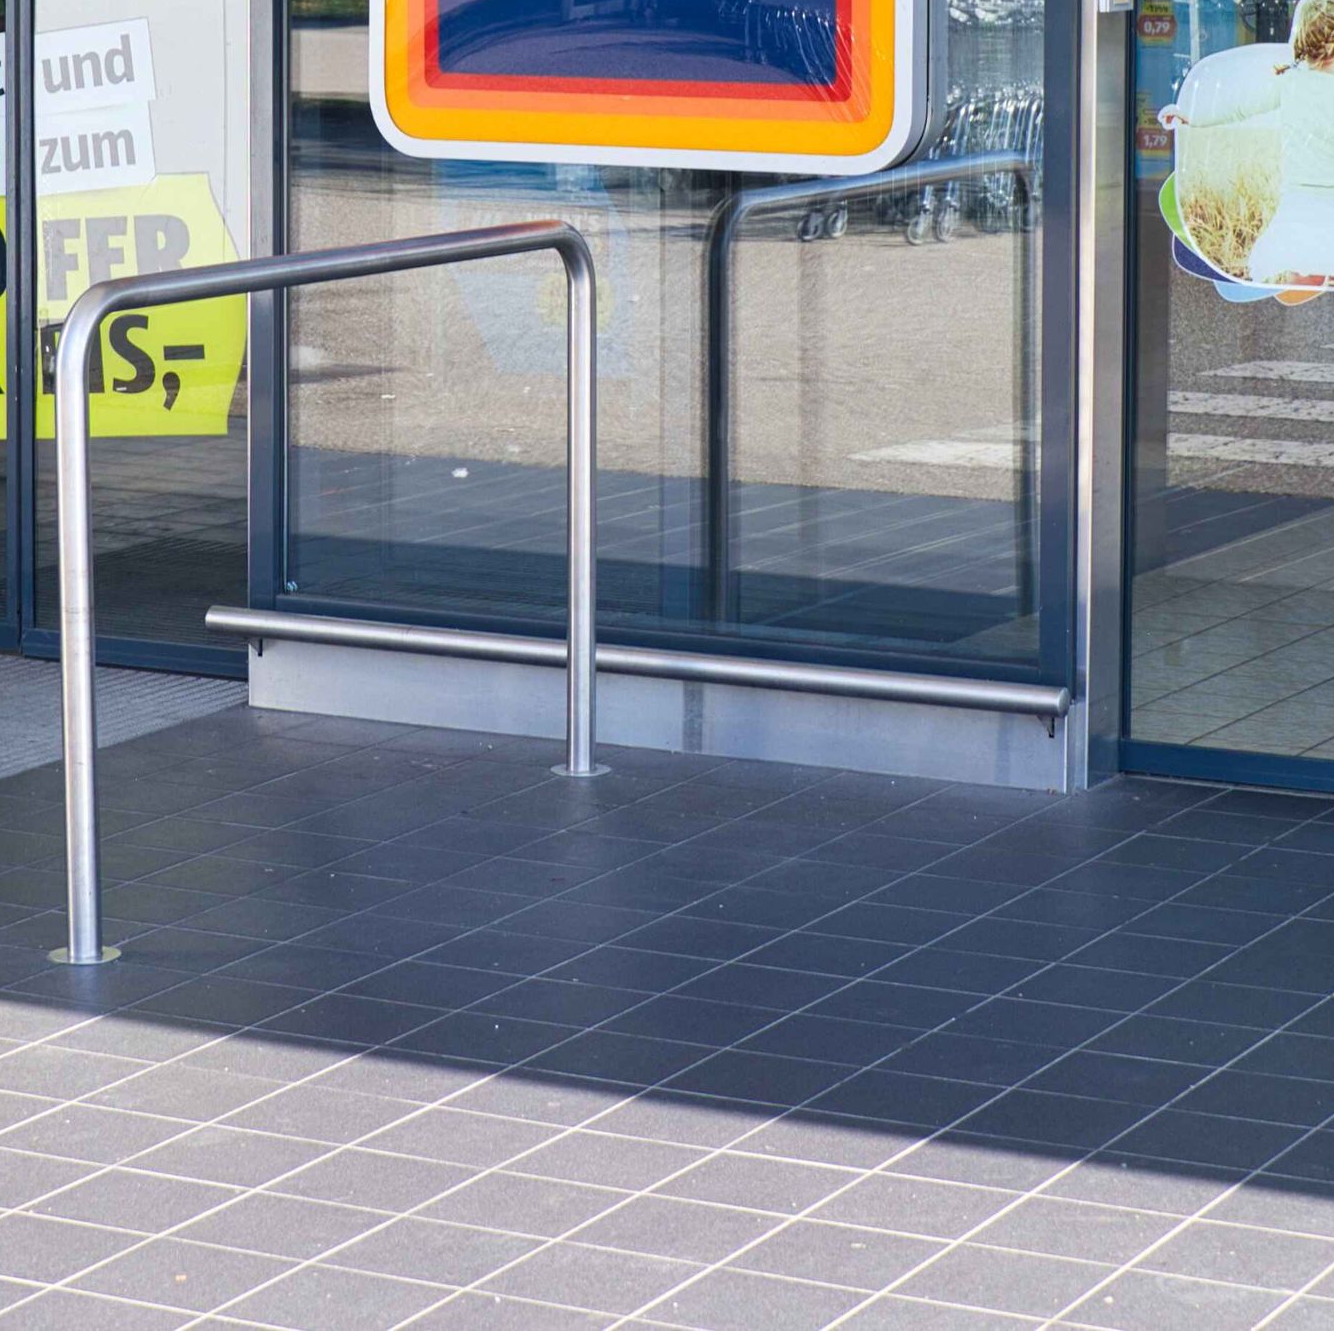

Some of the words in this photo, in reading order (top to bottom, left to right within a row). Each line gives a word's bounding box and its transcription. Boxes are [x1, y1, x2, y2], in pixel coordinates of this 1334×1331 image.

[1144, 21, 1170, 34] 0,79
[42, 34, 136, 94] und
[40, 125, 137, 175] zum
[1143, 134, 1168, 146] 1,79
